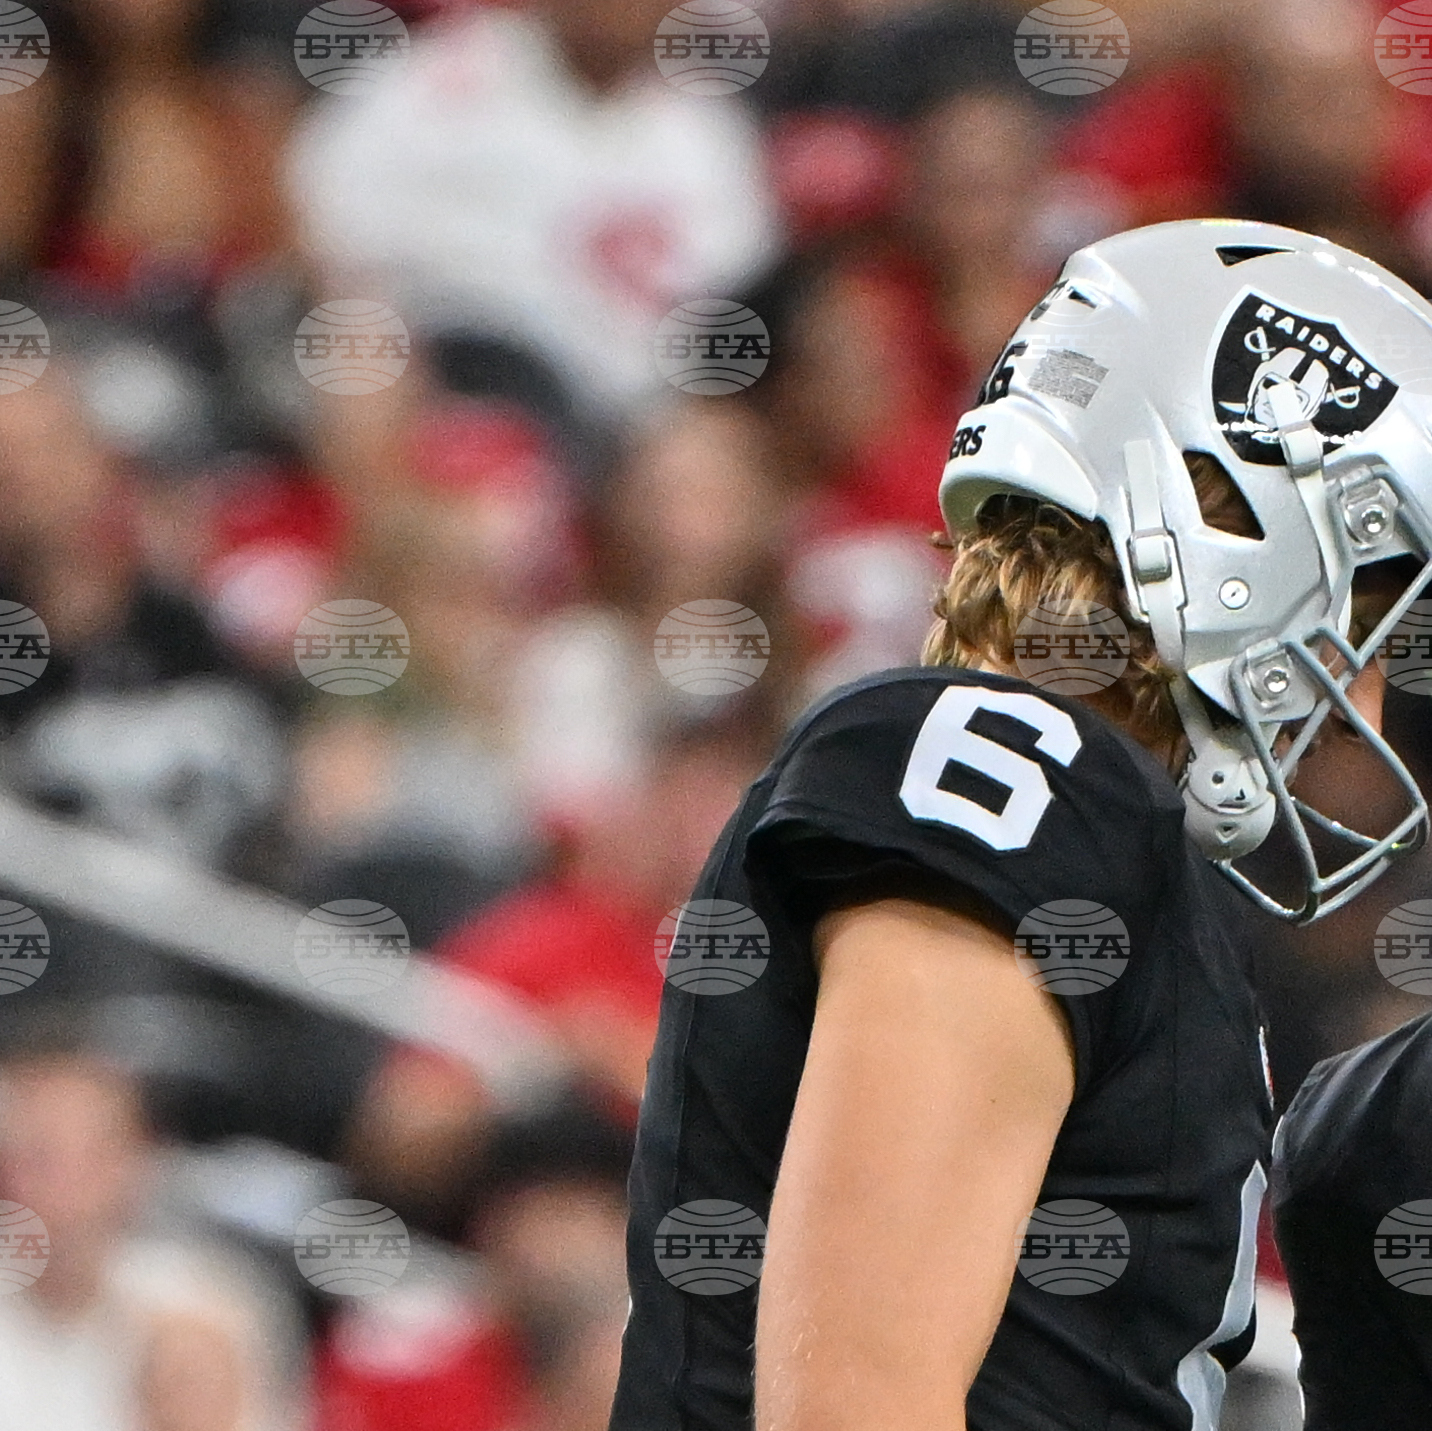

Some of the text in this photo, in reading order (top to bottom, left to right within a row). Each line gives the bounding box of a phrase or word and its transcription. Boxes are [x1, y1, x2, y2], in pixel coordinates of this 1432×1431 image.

[1255, 303, 1383, 390] RAIDERS
[949, 425, 987, 460] ERS
[899, 685, 1082, 851] 6
